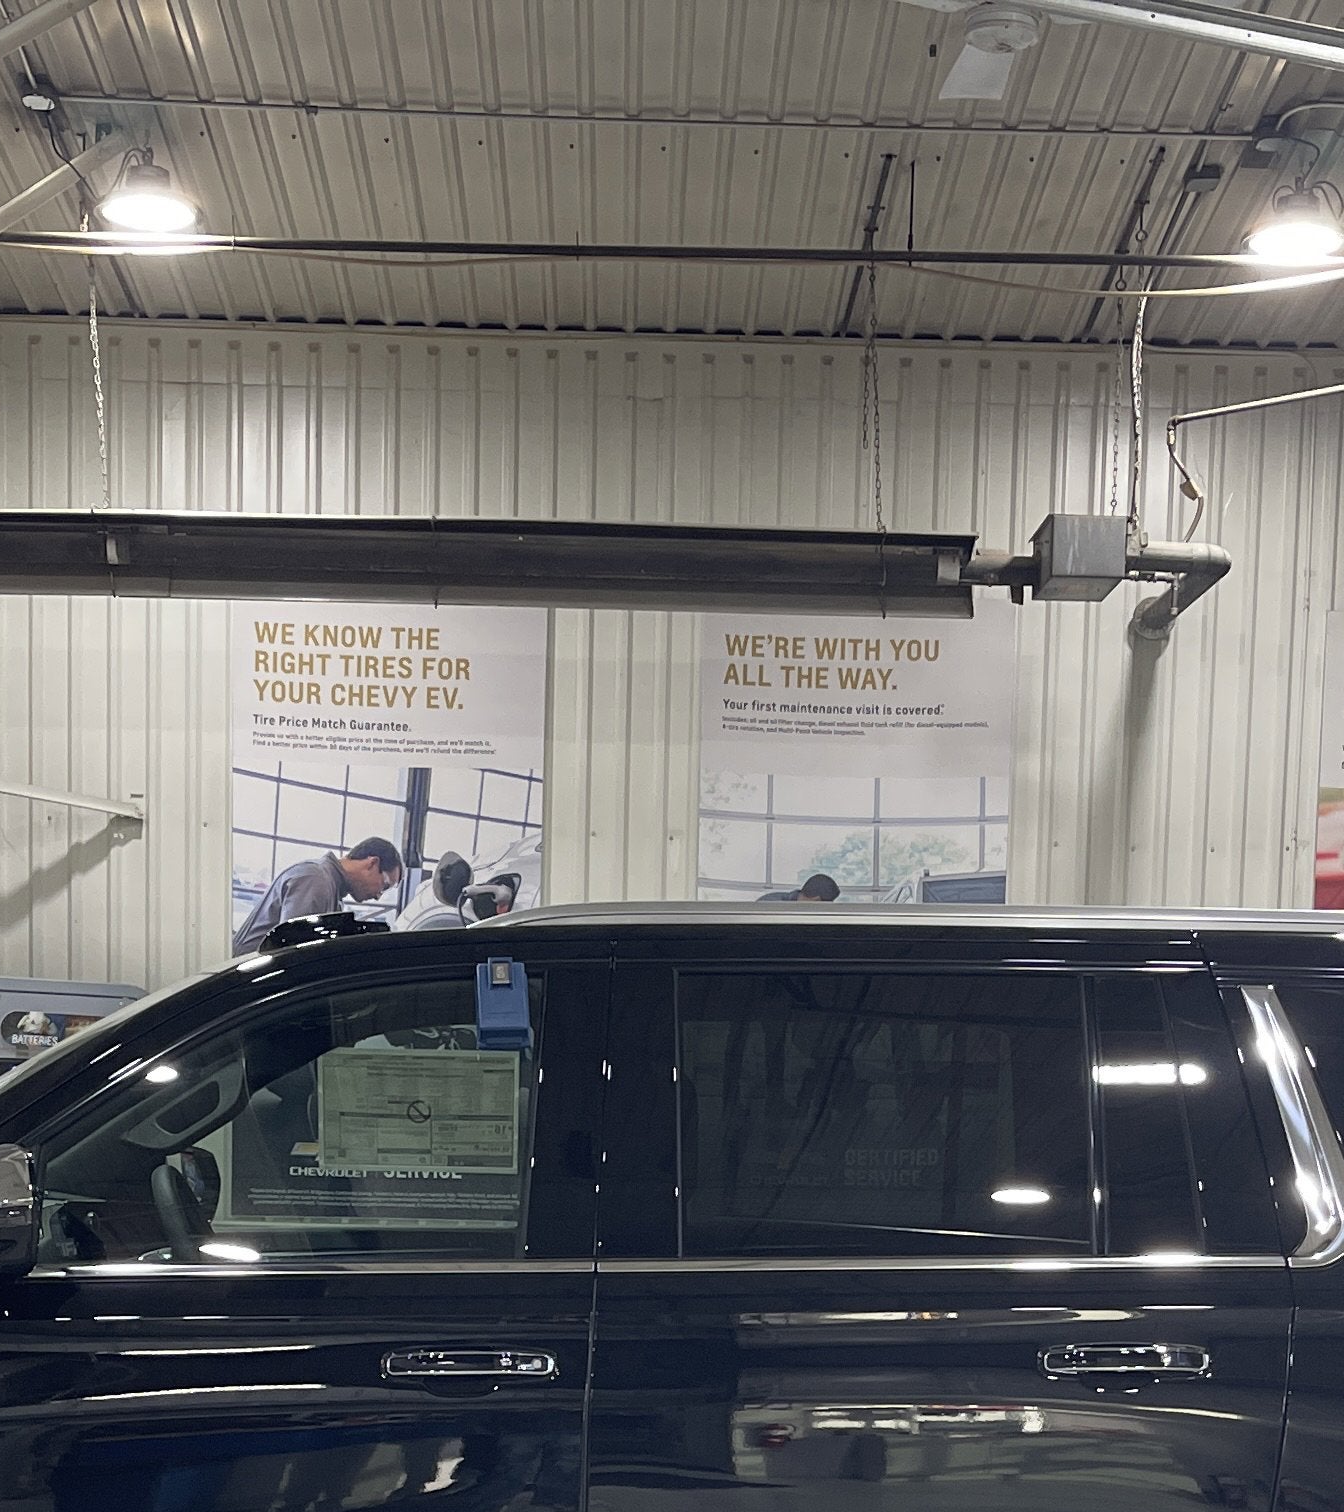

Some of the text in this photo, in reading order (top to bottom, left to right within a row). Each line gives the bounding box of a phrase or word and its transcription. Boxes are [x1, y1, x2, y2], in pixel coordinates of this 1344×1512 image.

[254, 621, 440, 650] WE KNOW THE
[725, 634, 940, 662] WE'RE WITH YOU
[254, 650, 471, 680] RIGHT TIRES FOR
[723, 664, 898, 690] ALL THE WAY.
[253, 679, 464, 710] YOUR CHEVY EV.
[723, 699, 748, 710] Your
[752, 700, 776, 712] first
[780, 702, 852, 714] maintenance
[856, 704, 880, 714] visit
[883, 704, 892, 715] is
[253, 714, 412, 732] Tire Price Match Guarantee.
[12, 1034, 58, 1046] BATTERIES
[289, 1166, 367, 1178] CHEVROLET
